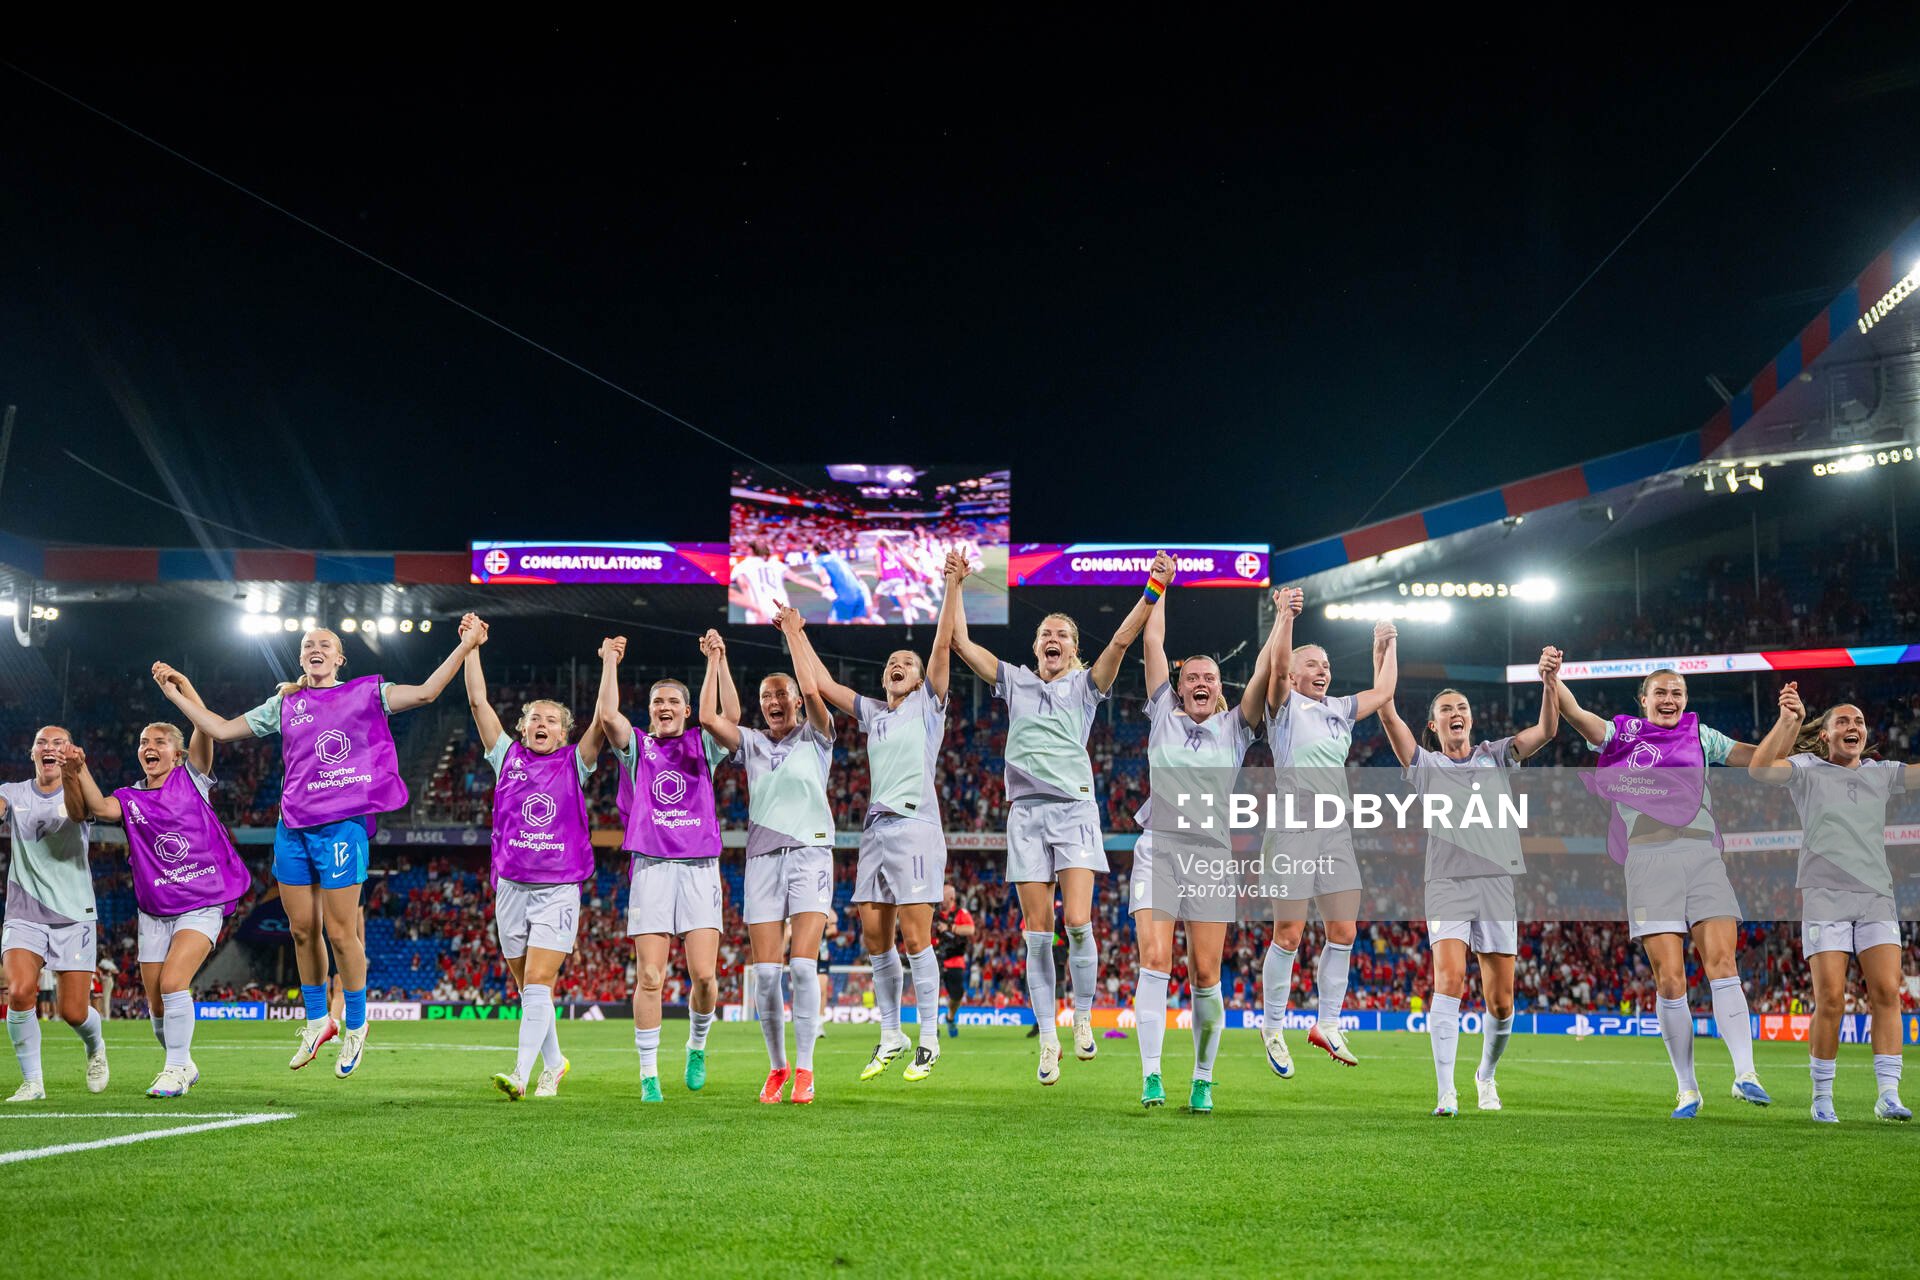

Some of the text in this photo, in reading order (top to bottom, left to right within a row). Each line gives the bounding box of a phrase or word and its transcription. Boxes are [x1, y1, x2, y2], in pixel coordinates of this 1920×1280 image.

[519, 555, 663, 571] CONGRATULATIONS
[1070, 557, 1215, 572] CONGRATUIONS
[1590, 662, 1643, 675] WOMEN'S
[1679, 659, 1709, 671] 2025
[318, 766, 357, 781] Together
[1619, 774, 1656, 786] Together
[307, 773, 373, 791] #WePlayStrong
[405, 831, 447, 843] BASEL
[519, 830, 555, 844] Together
[508, 839, 566, 852] #WePlayStrong
[332, 841, 350, 868] 12
[162, 861, 199, 878] Together
[911, 854, 925, 881] 11
[200, 1006, 258, 1019] RECYCLE
[427, 1005, 493, 1020] PLAY
[1600, 1017, 1660, 1036] PS5
